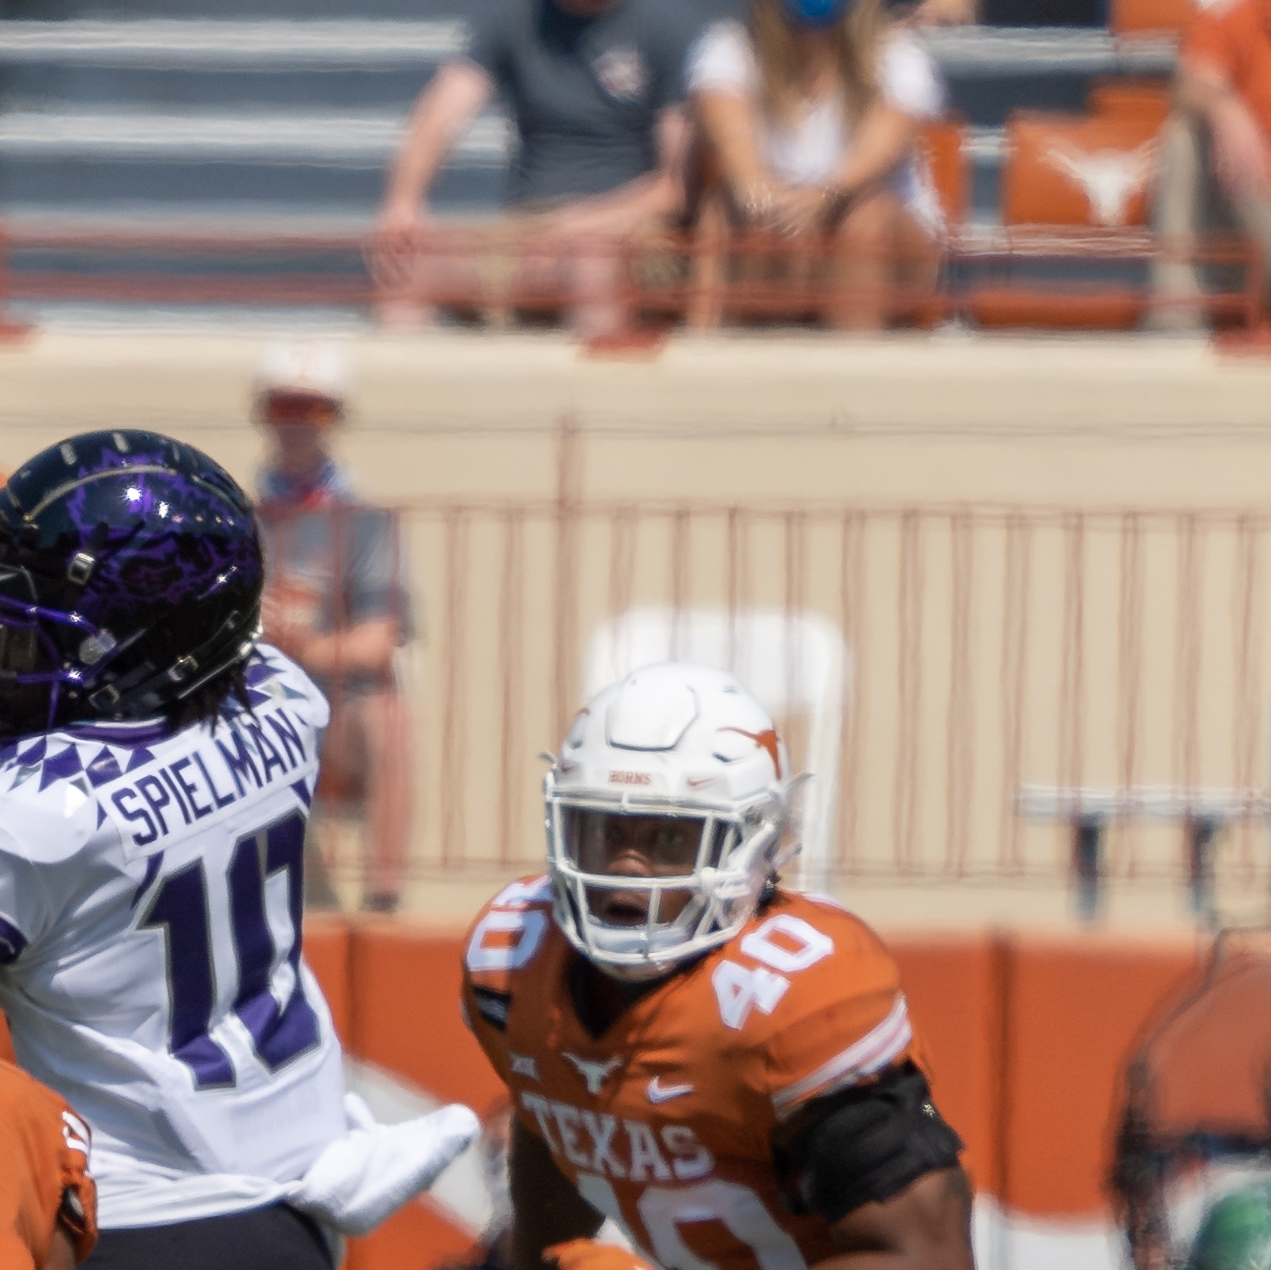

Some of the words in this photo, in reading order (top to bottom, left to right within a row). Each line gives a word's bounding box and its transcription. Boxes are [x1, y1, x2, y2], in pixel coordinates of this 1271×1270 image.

[110, 709, 308, 847] SPIELMAN
[134, 806, 322, 1092] 10
[711, 914, 835, 1030] 40
[520, 1092, 715, 1183] TEXAS
